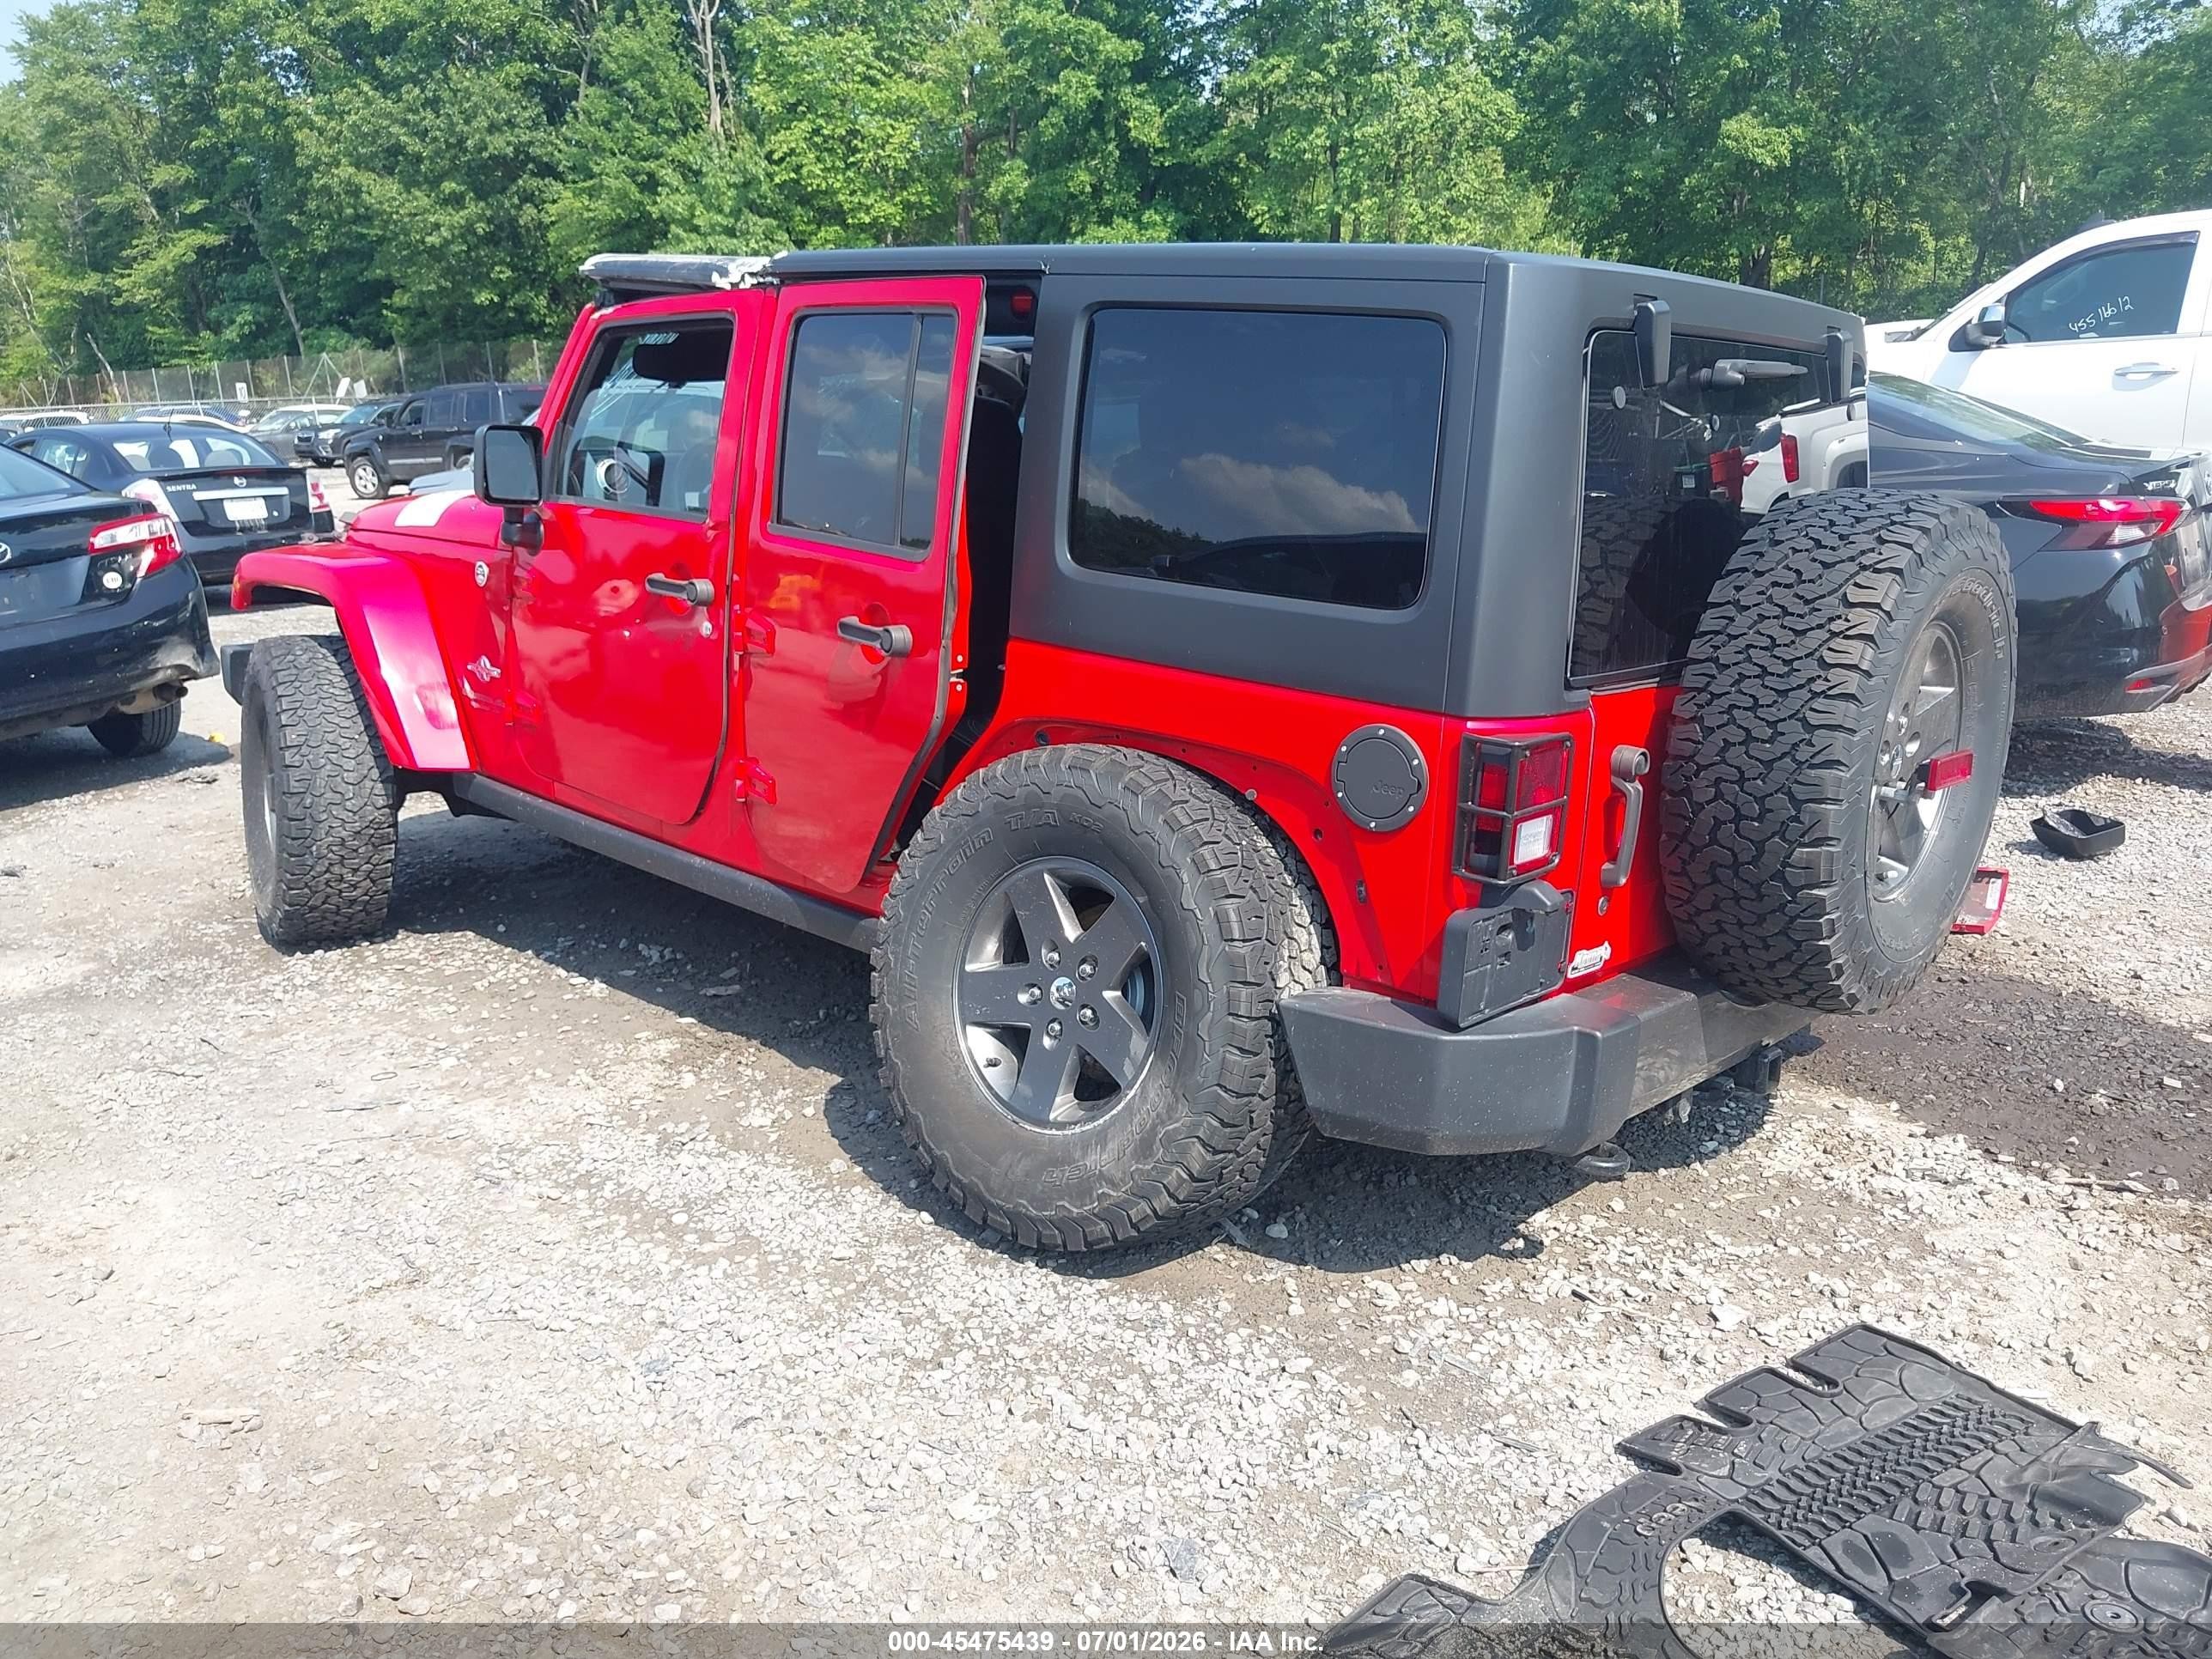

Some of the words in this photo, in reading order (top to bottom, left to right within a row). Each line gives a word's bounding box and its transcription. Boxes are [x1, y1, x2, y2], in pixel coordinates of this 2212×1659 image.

[2069, 295, 2134, 332] 45516612
[166, 483, 197, 492] SENTRA
[1370, 779, 1405, 799] Jeep
[1003, 807, 1060, 832] T/A
